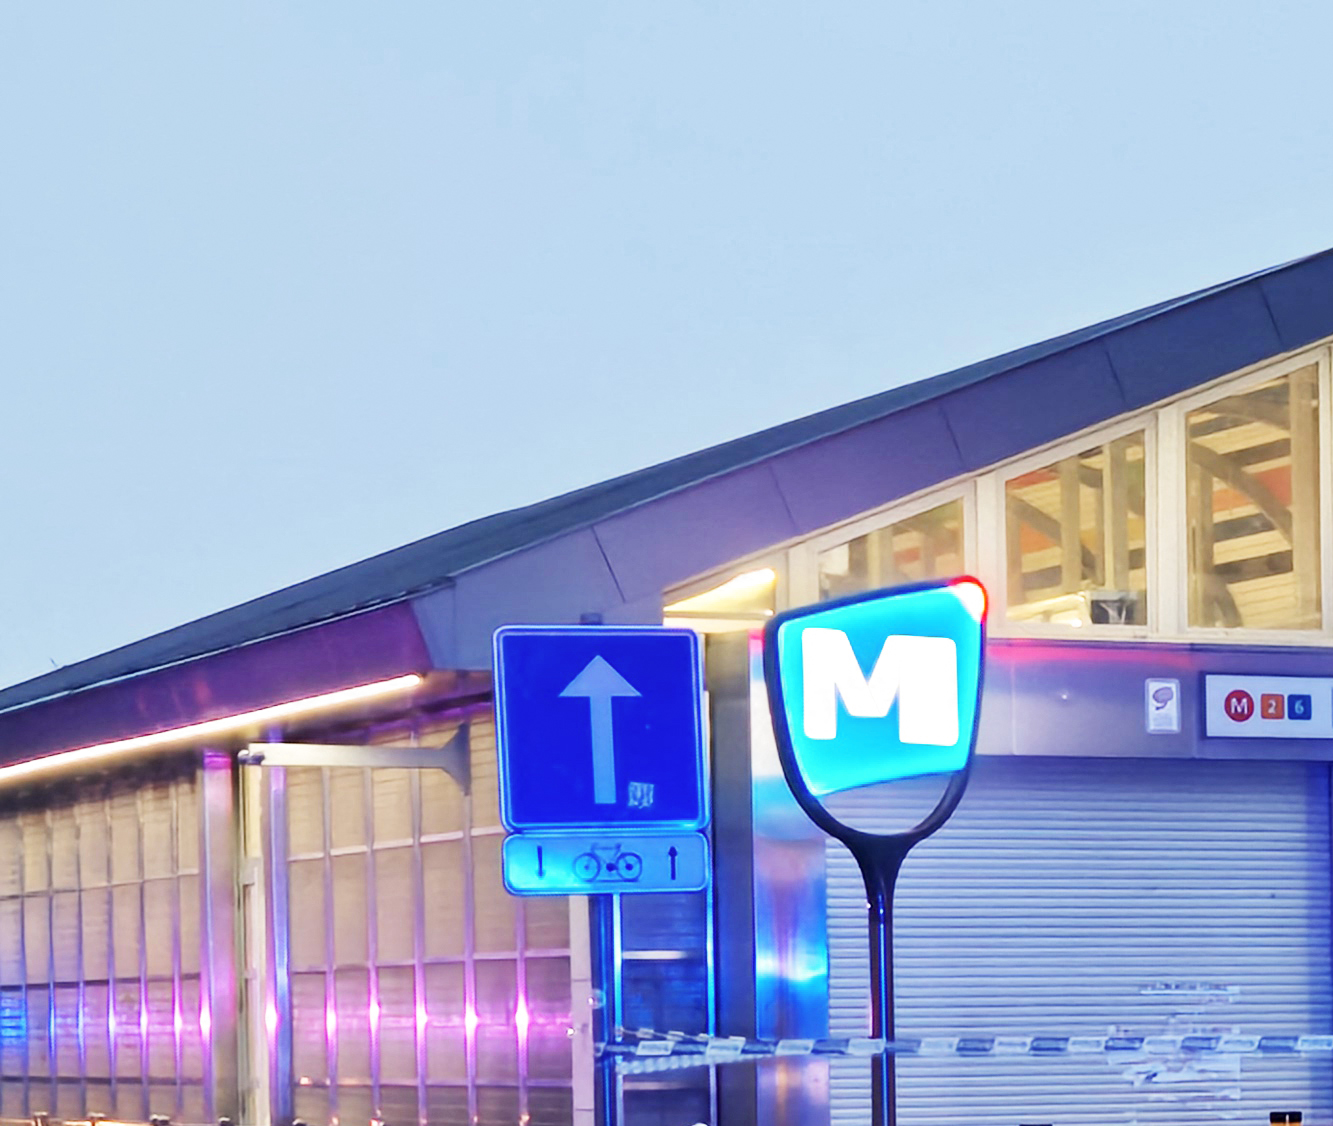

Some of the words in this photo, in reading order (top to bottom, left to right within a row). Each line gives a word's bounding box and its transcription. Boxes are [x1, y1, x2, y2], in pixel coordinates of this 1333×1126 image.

[801, 628, 959, 746] M
[1230, 697, 1248, 715] M
[1267, 699, 1277, 715] 2
[1294, 699, 1305, 715] 6
